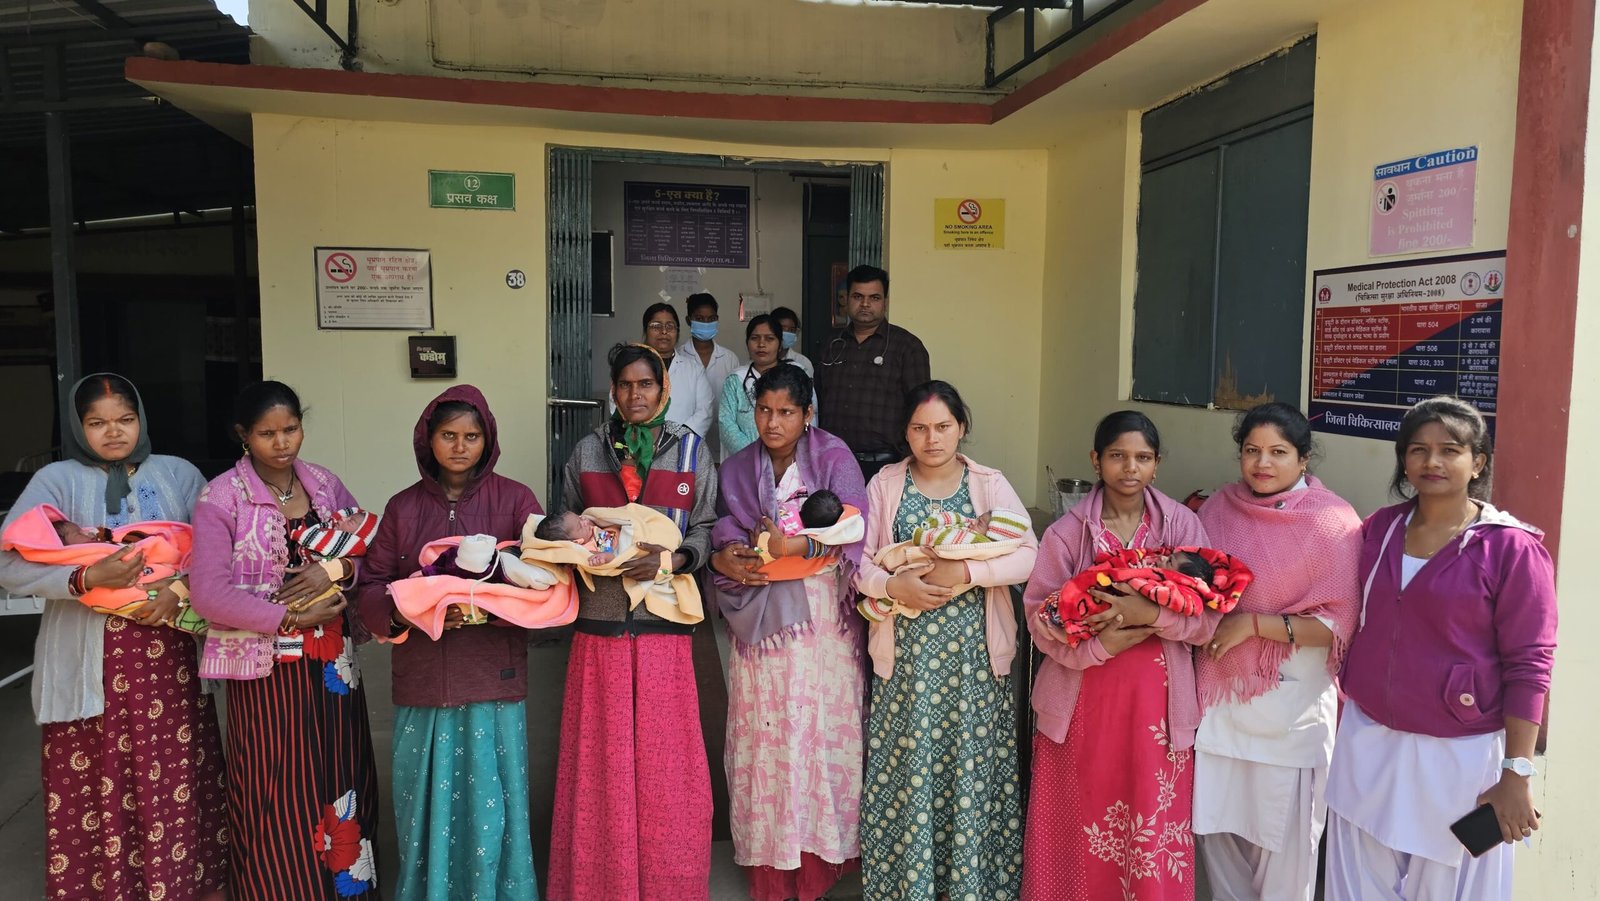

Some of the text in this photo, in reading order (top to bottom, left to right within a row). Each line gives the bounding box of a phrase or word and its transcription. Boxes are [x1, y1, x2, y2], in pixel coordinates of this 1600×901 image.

[1376, 148, 1475, 178] सावधान Caution
[466, 178, 478, 188] 12
[446, 193, 498, 204] प्रसव कक्ष
[684, 190, 702, 200] क्या
[1402, 206, 1444, 222] Spitting
[1398, 218, 1453, 234] Prohibited
[508, 272, 524, 286] 38
[1348, 282, 1374, 292] Medical
[1376, 278, 1416, 290] Protection
[1418, 277, 1434, 286] Act
[1436, 275, 1456, 285] 2008
[1445, 303, 1460, 311] (IPC)
[419, 350, 446, 361] कंडोम
[1326, 410, 1401, 431] जिला चिकित्सालय
